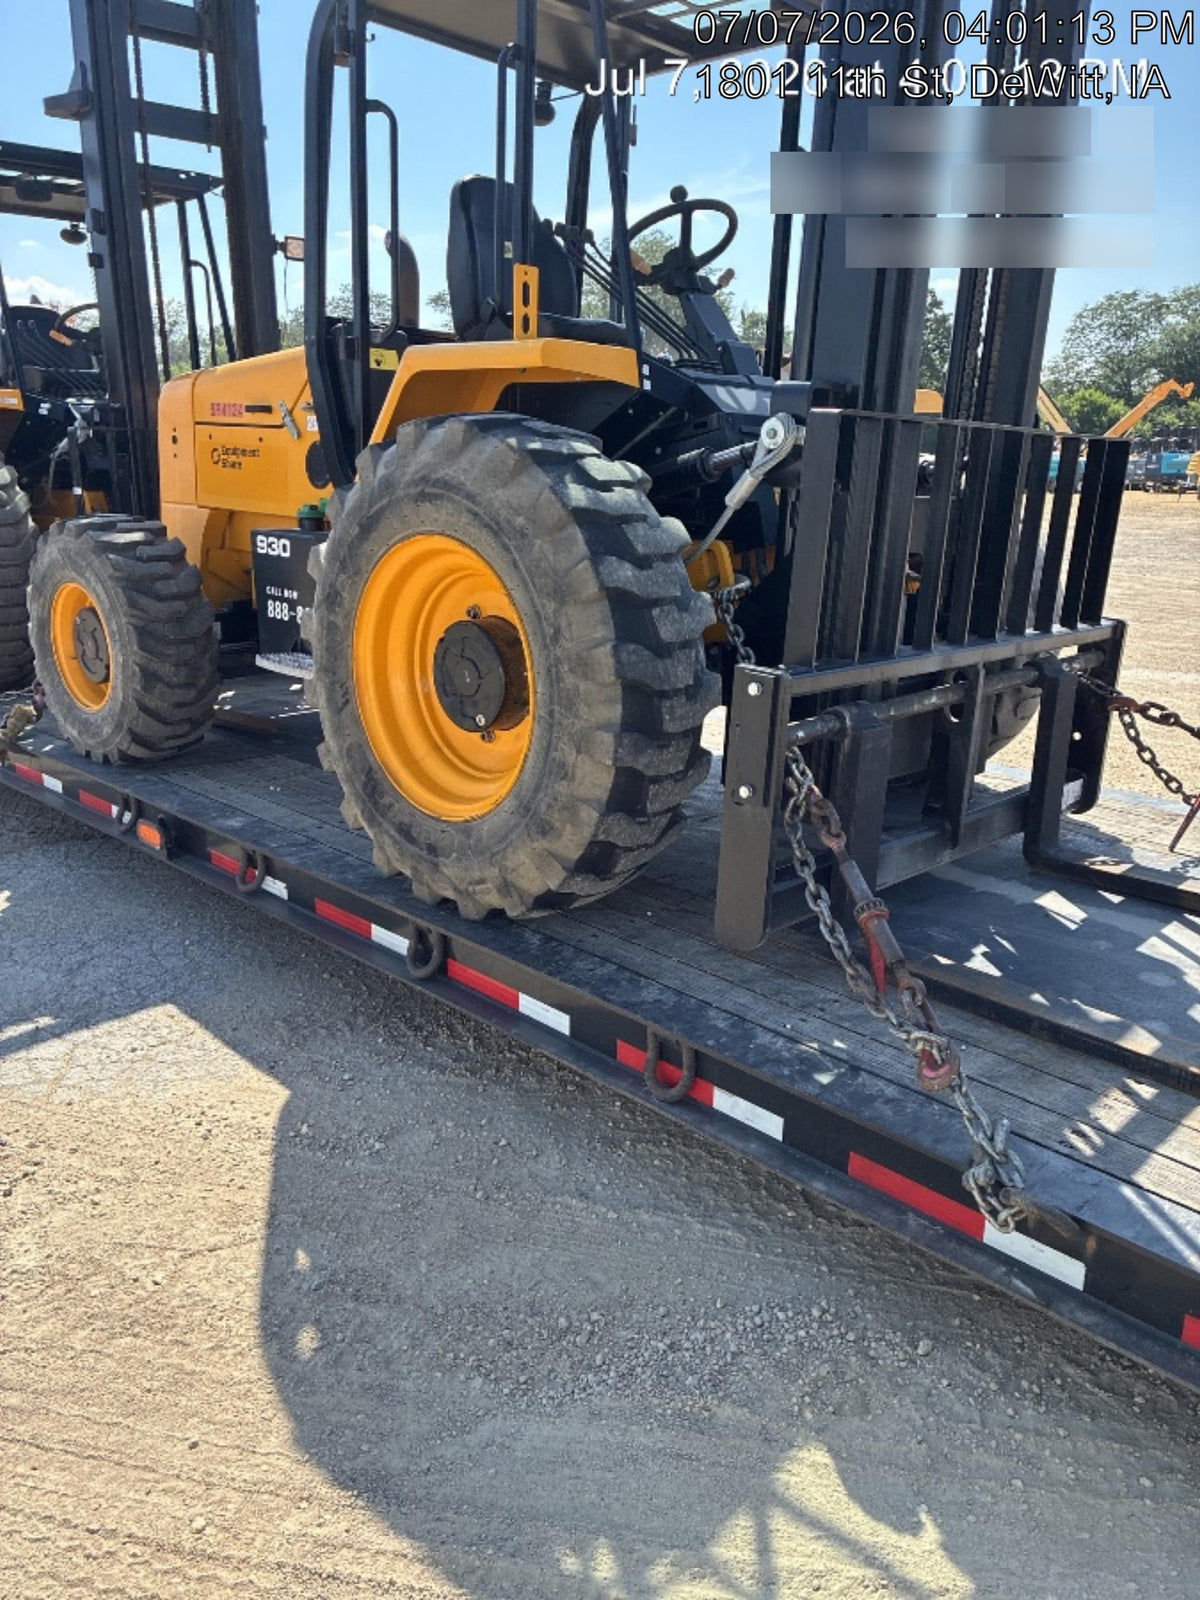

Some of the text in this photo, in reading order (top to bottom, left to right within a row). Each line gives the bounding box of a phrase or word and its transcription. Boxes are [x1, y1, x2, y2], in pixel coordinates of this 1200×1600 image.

[221, 445, 260, 459] Equipment
[221, 458, 242, 470] Share
[256, 534, 291, 557] 930
[266, 586, 298, 600] CALL NOW
